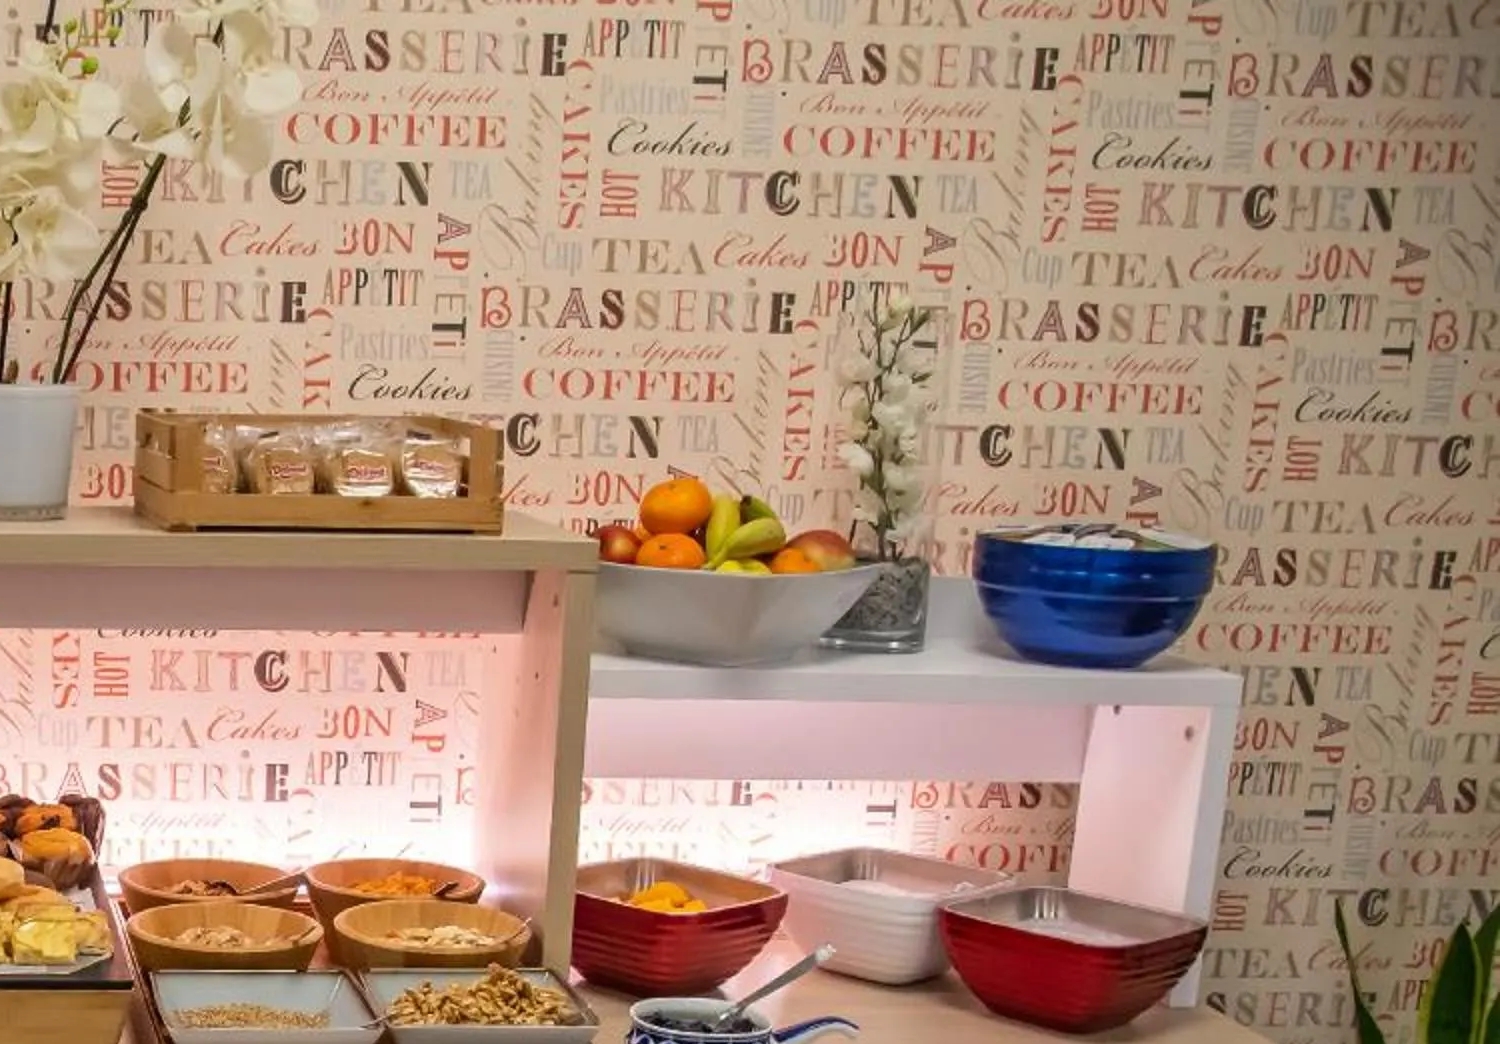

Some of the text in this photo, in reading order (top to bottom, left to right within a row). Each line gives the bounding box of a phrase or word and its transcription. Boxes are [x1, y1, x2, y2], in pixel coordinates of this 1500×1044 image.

[1348, 0, 1457, 39] TEA
[283, 20, 568, 76] RASSERIE
[287, 111, 507, 147] COFFEE
[558, 59, 593, 229] CAKES
[607, 117, 733, 156] Cookies
[782, 125, 996, 162] COFFEE
[1041, 75, 1082, 243] CAKES
[1092, 132, 1213, 171] Cookies
[1264, 137, 1476, 175] COFFEE
[600, 169, 640, 217] HOT
[660, 168, 922, 218] KITCHEN
[1082, 184, 1122, 232] HOT
[1138, 179, 1398, 232] KITCHEN
[221, 222, 317, 258] Cakes
[334, 218, 416, 257] BON
[714, 234, 808, 269] Cakes
[823, 231, 904, 269] BON
[592, 238, 706, 275] TEA
[1073, 251, 1181, 288] TEA
[1190, 247, 1280, 282] Cakes
[1298, 244, 1376, 281] BON
[348, 363, 473, 401] Cookies
[523, 367, 735, 402] COFFEE
[781, 319, 819, 481] CAKES
[998, 380, 1202, 415] COFFEE
[1244, 333, 1287, 492] CAKES
[1296, 387, 1410, 424] Cookies
[1146, 427, 1185, 464] TEA
[1283, 435, 1322, 480] HOT
[567, 470, 645, 507] BON
[1034, 481, 1112, 517] BON
[1273, 499, 1375, 534] TEA
[1386, 495, 1472, 528] Cakes
[1198, 622, 1391, 654] COFFEE
[1428, 574, 1474, 725] CAKES
[93, 652, 131, 697] HOT
[153, 649, 408, 693] KITCHEN
[87, 715, 200, 749] TEA
[208, 709, 299, 742] Cakes
[315, 705, 394, 740] BON
[1224, 846, 1333, 880] Cookies
[1211, 890, 1249, 931] HOT
